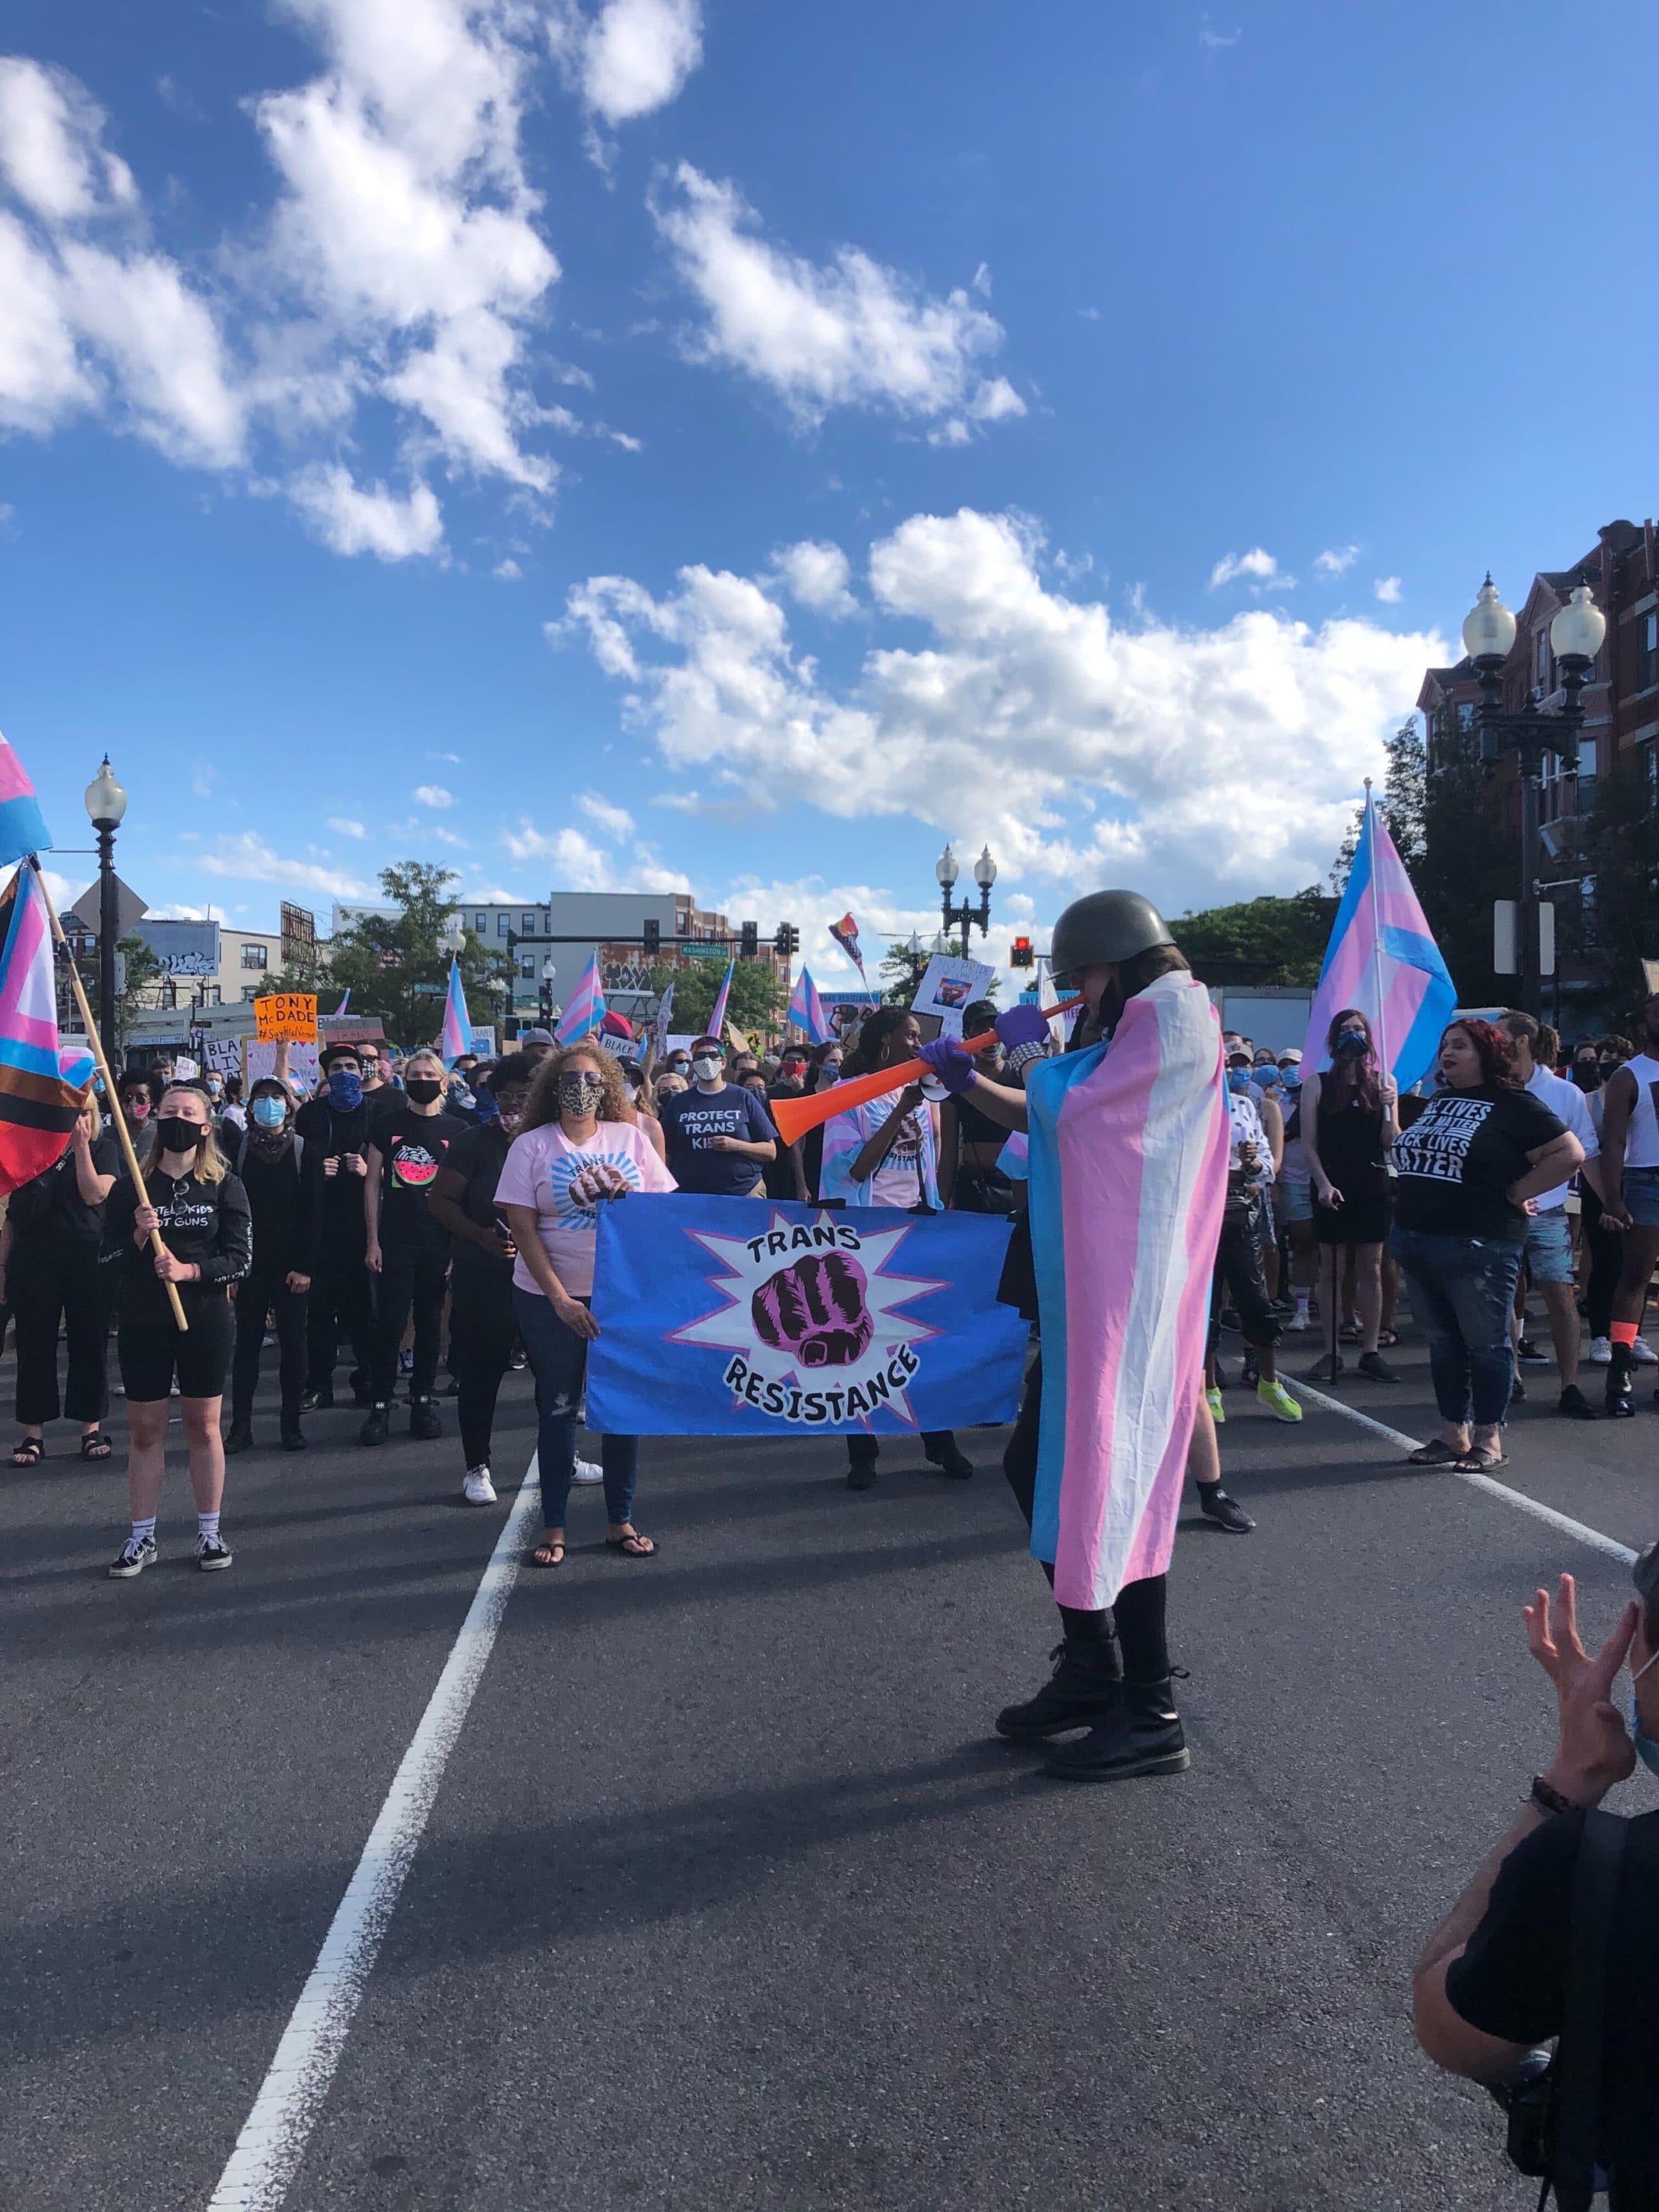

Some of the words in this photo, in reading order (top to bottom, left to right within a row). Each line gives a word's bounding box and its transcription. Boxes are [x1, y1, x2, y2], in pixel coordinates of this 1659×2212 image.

[683, 946, 721, 955] WASHINGTON
[961, 961, 990, 977] PRIDE
[260, 996, 312, 1012] TONY
[208, 1040, 242, 1056] BLA
[605, 1038, 634, 1055] BLACK
[679, 1110, 741, 1123] PROTECT
[1441, 1100, 1491, 1121] LIVES
[684, 1121, 736, 1134] TRANS
[1434, 1116, 1481, 1130] MATTER
[1391, 1134, 1425, 1148] LACK
[1427, 1135, 1470, 1158] LIVES
[568, 1158, 605, 1177] TRANS
[158, 1218, 172, 1227] OT
[174, 1217, 208, 1226] GUNS
[747, 1227, 861, 1263] TRANS
[214, 1270, 245, 1284] ACTION
[727, 1344, 918, 1421] RESISTANCE
